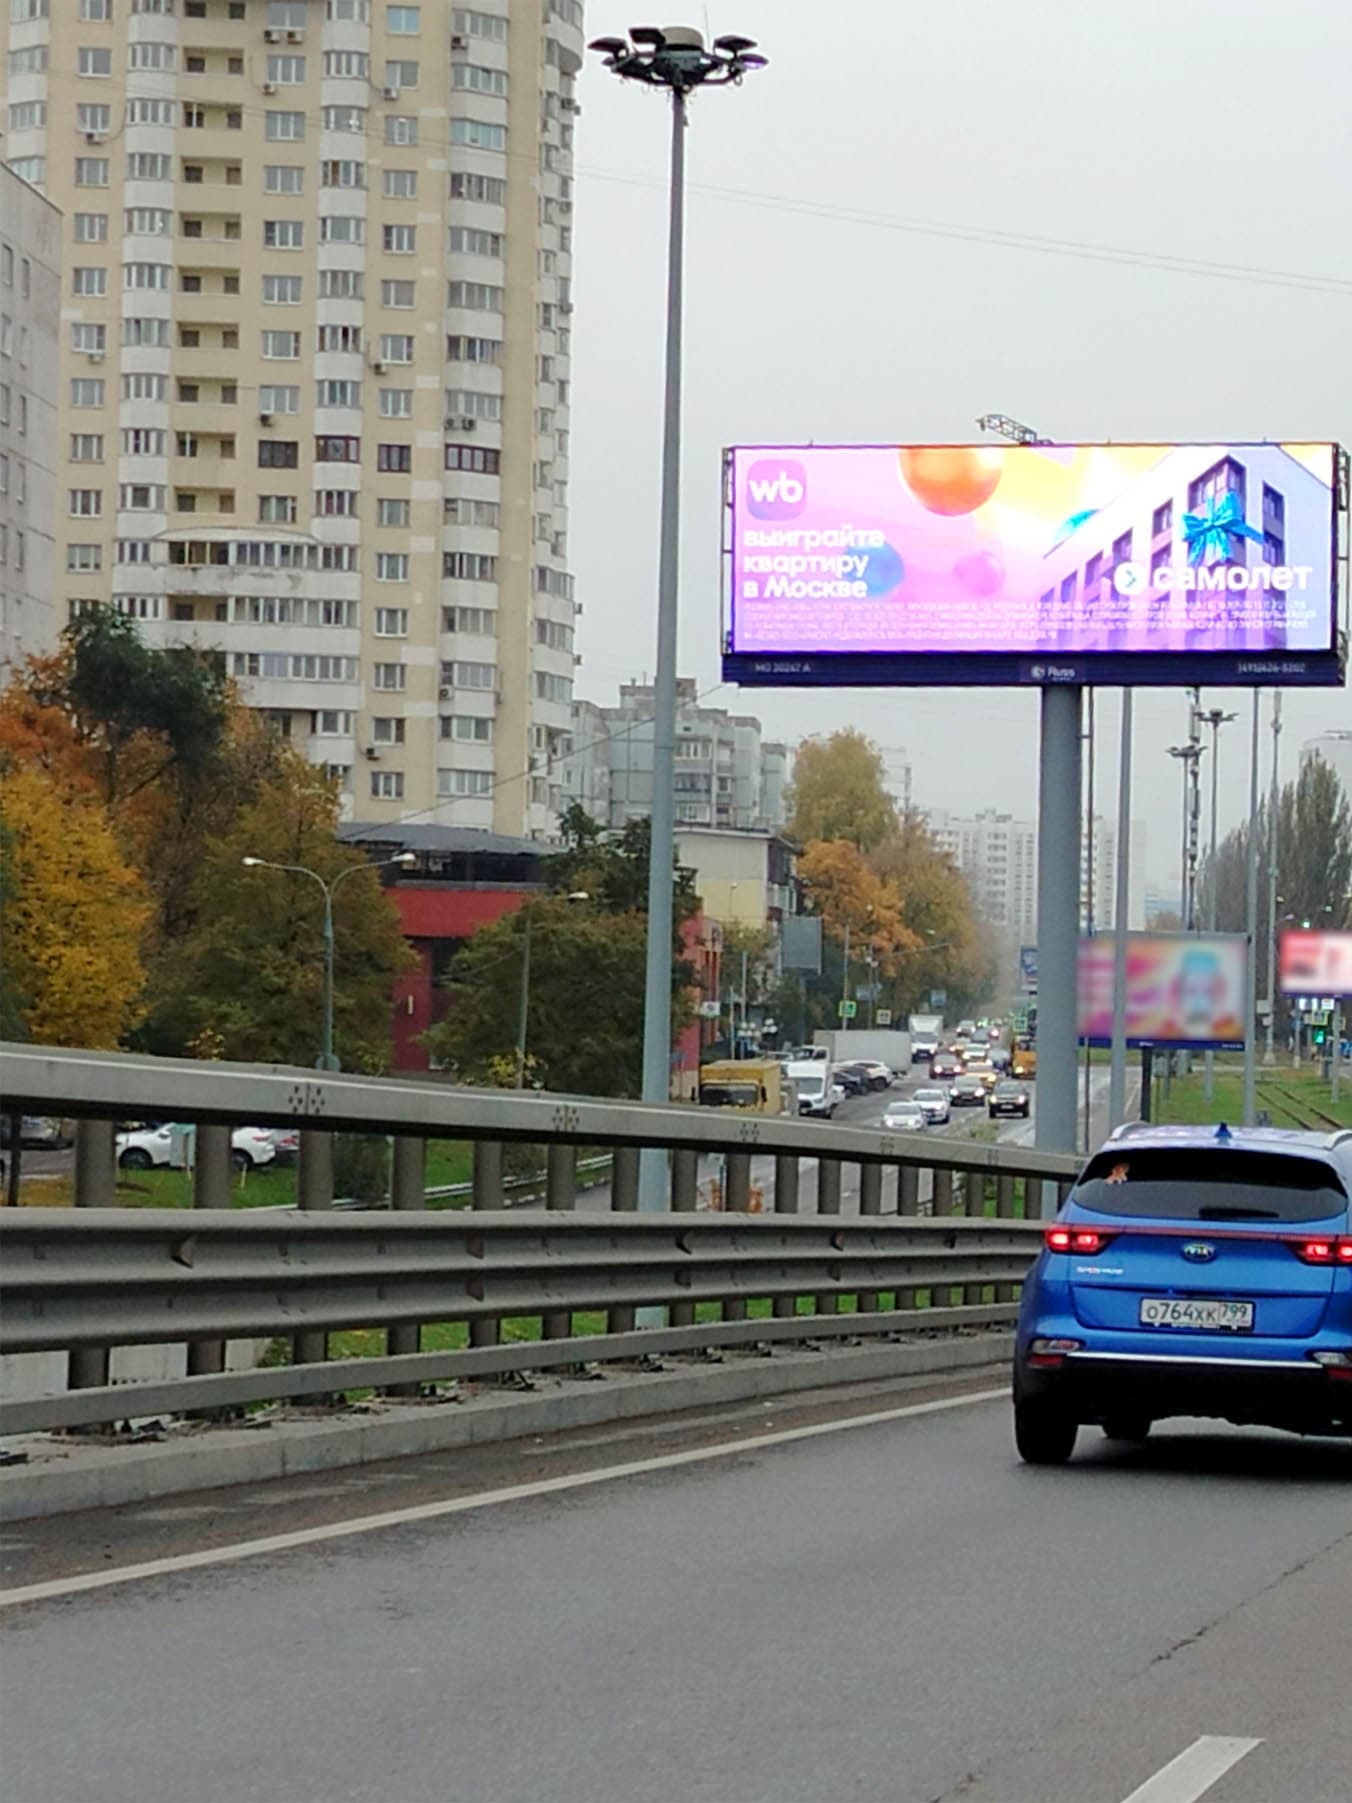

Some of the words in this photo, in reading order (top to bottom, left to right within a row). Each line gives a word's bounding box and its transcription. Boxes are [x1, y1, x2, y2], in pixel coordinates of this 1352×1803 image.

[749, 471, 804, 504] wb
[743, 525, 885, 552] выиграйте
[743, 554, 869, 578] квартиру
[1152, 565, 1313, 591] самолет
[743, 581, 759, 598] в
[763, 575, 868, 598] Москве
